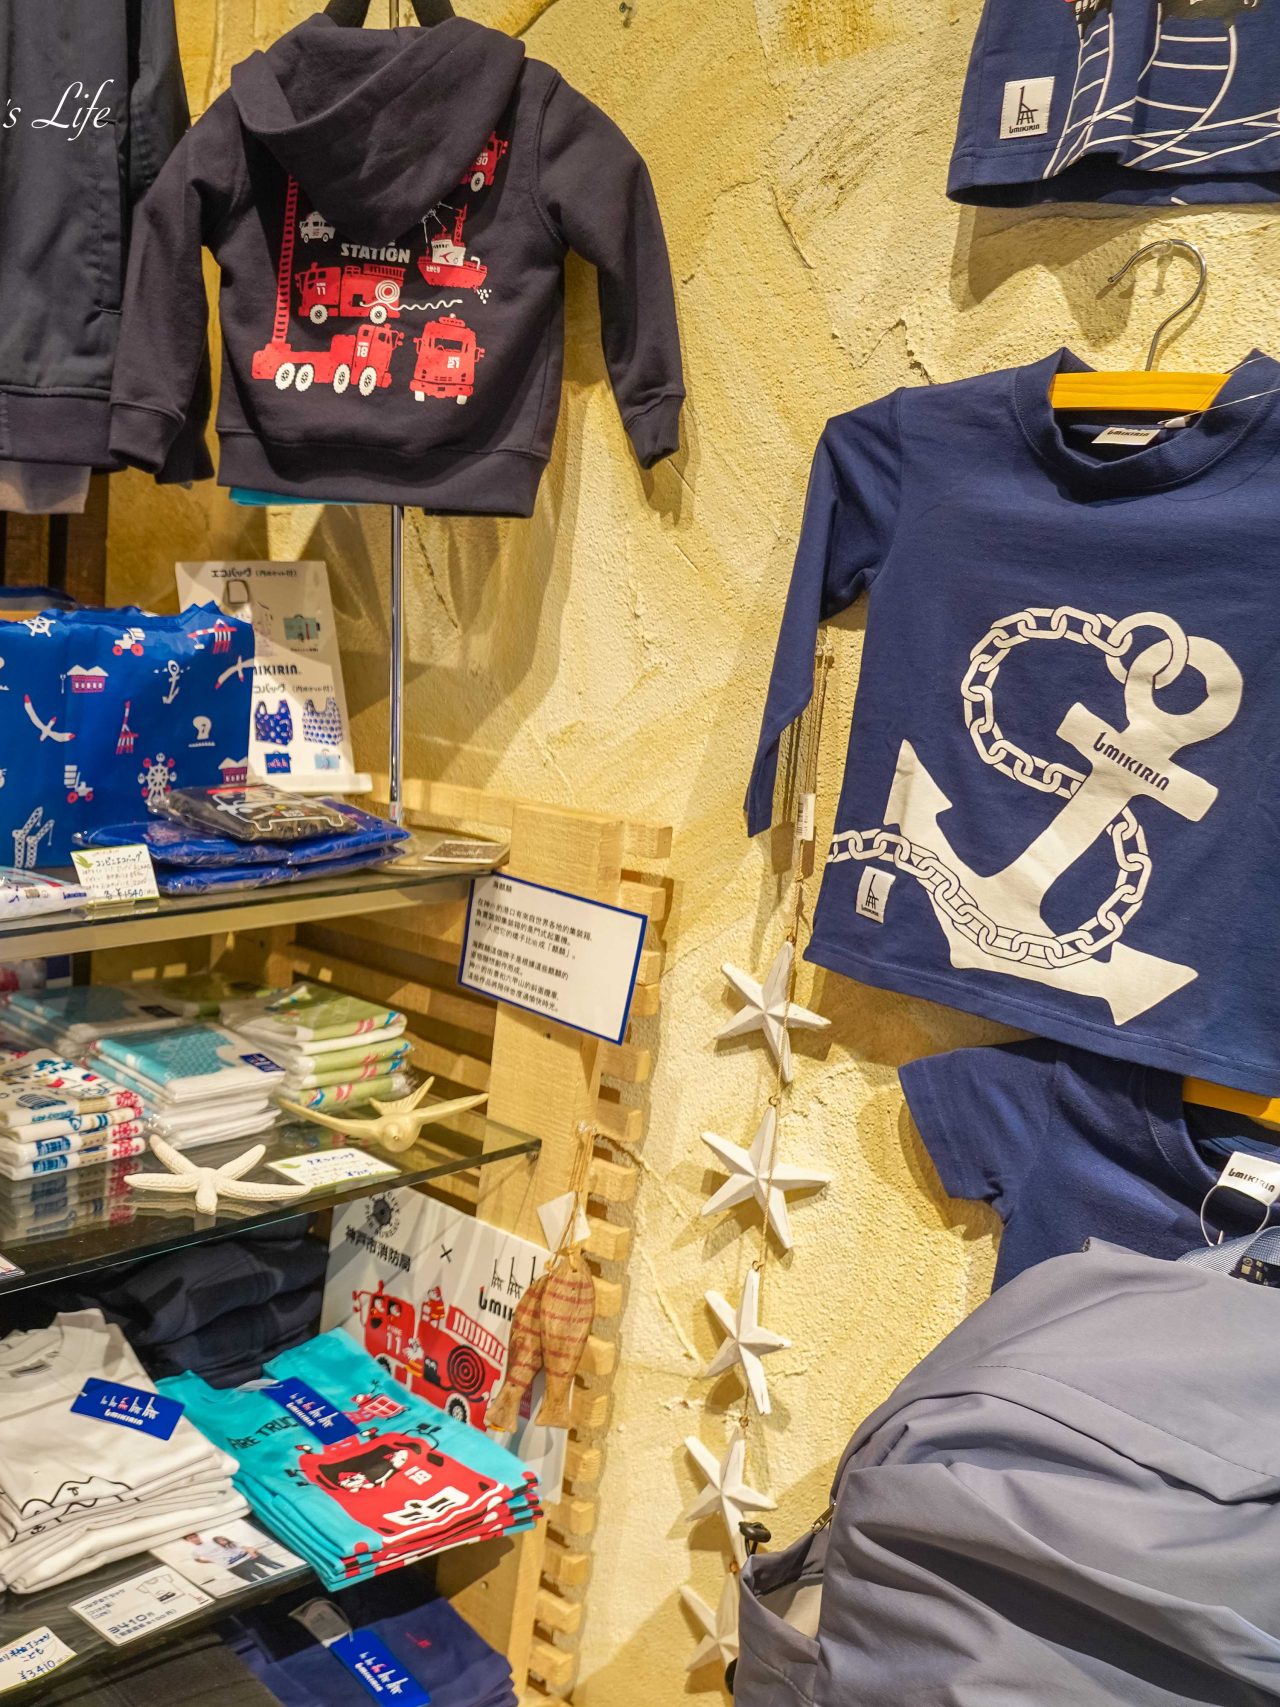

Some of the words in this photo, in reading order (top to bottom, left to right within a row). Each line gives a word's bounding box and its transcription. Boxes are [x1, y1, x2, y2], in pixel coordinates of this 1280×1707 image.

[340, 242, 410, 264] STATION
[356, 345, 369, 358] 18
[253, 664, 298, 676] IKIRIN
[386, 1332, 401, 1354] 11
[256, 1416, 302, 1438] TRUC
